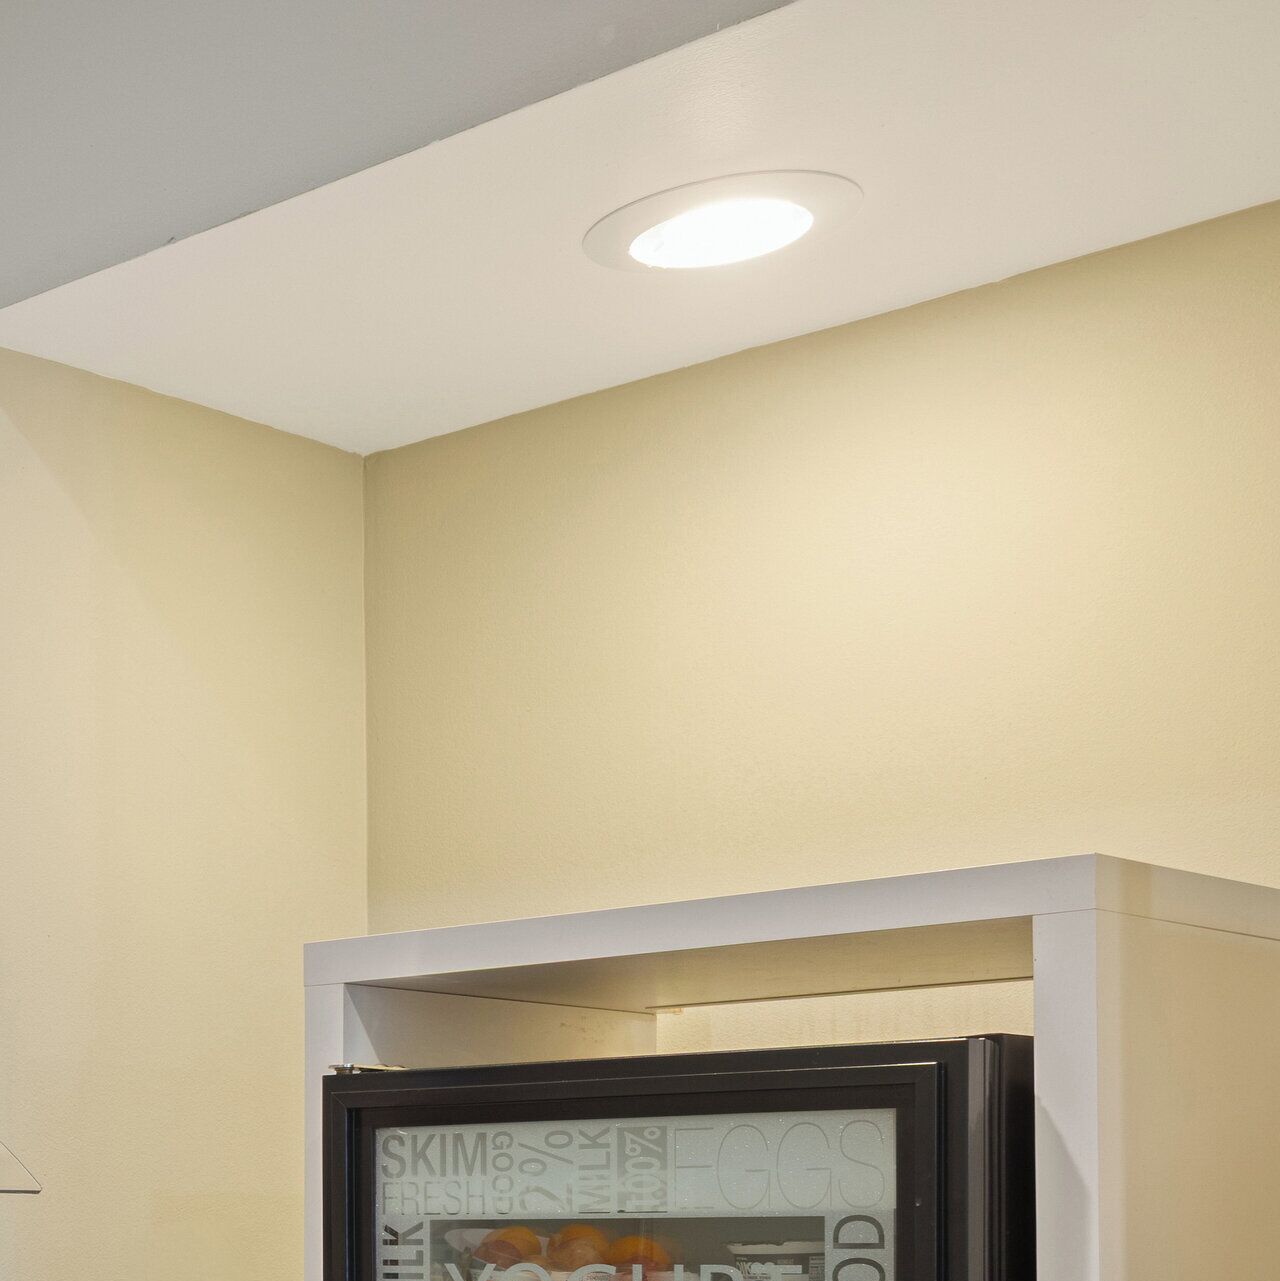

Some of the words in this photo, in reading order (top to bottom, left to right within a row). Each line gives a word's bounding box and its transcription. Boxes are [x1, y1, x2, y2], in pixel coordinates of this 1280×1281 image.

[381, 1131, 488, 1179] SKIM
[674, 1119, 886, 1210] EGGS
[381, 1180, 487, 1216] FRESH
